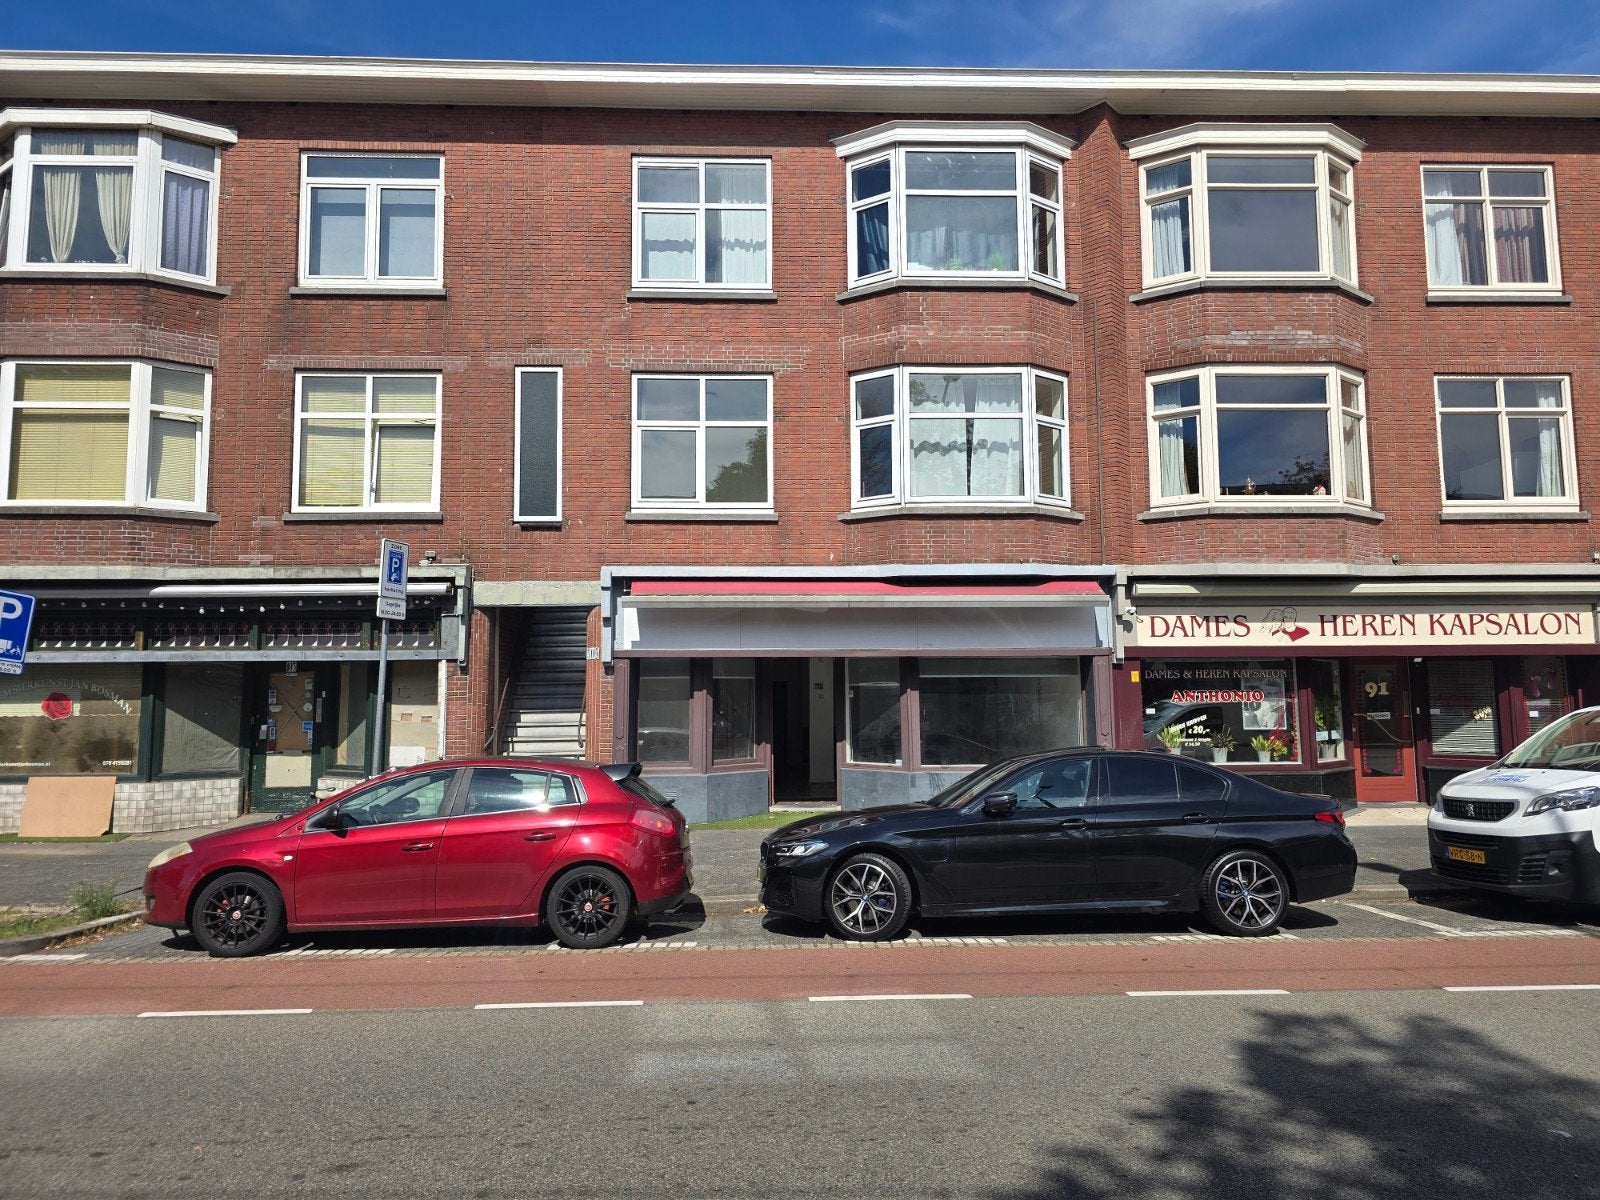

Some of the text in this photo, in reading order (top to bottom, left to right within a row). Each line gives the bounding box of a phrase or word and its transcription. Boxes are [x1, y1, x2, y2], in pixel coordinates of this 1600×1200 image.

[1149, 612, 1583, 638] DAMES HEREN KAPSALON
[1145, 669, 1181, 679] DAMES
[1183, 670, 1193, 679] &
[1195, 669, 1230, 679] HEREN
[1233, 669, 1287, 679] KAPSALON
[1170, 689, 1265, 703] ANTHONIO
[1364, 681, 1390, 698] 91
[90, 683, 132, 714] BOSMAN
